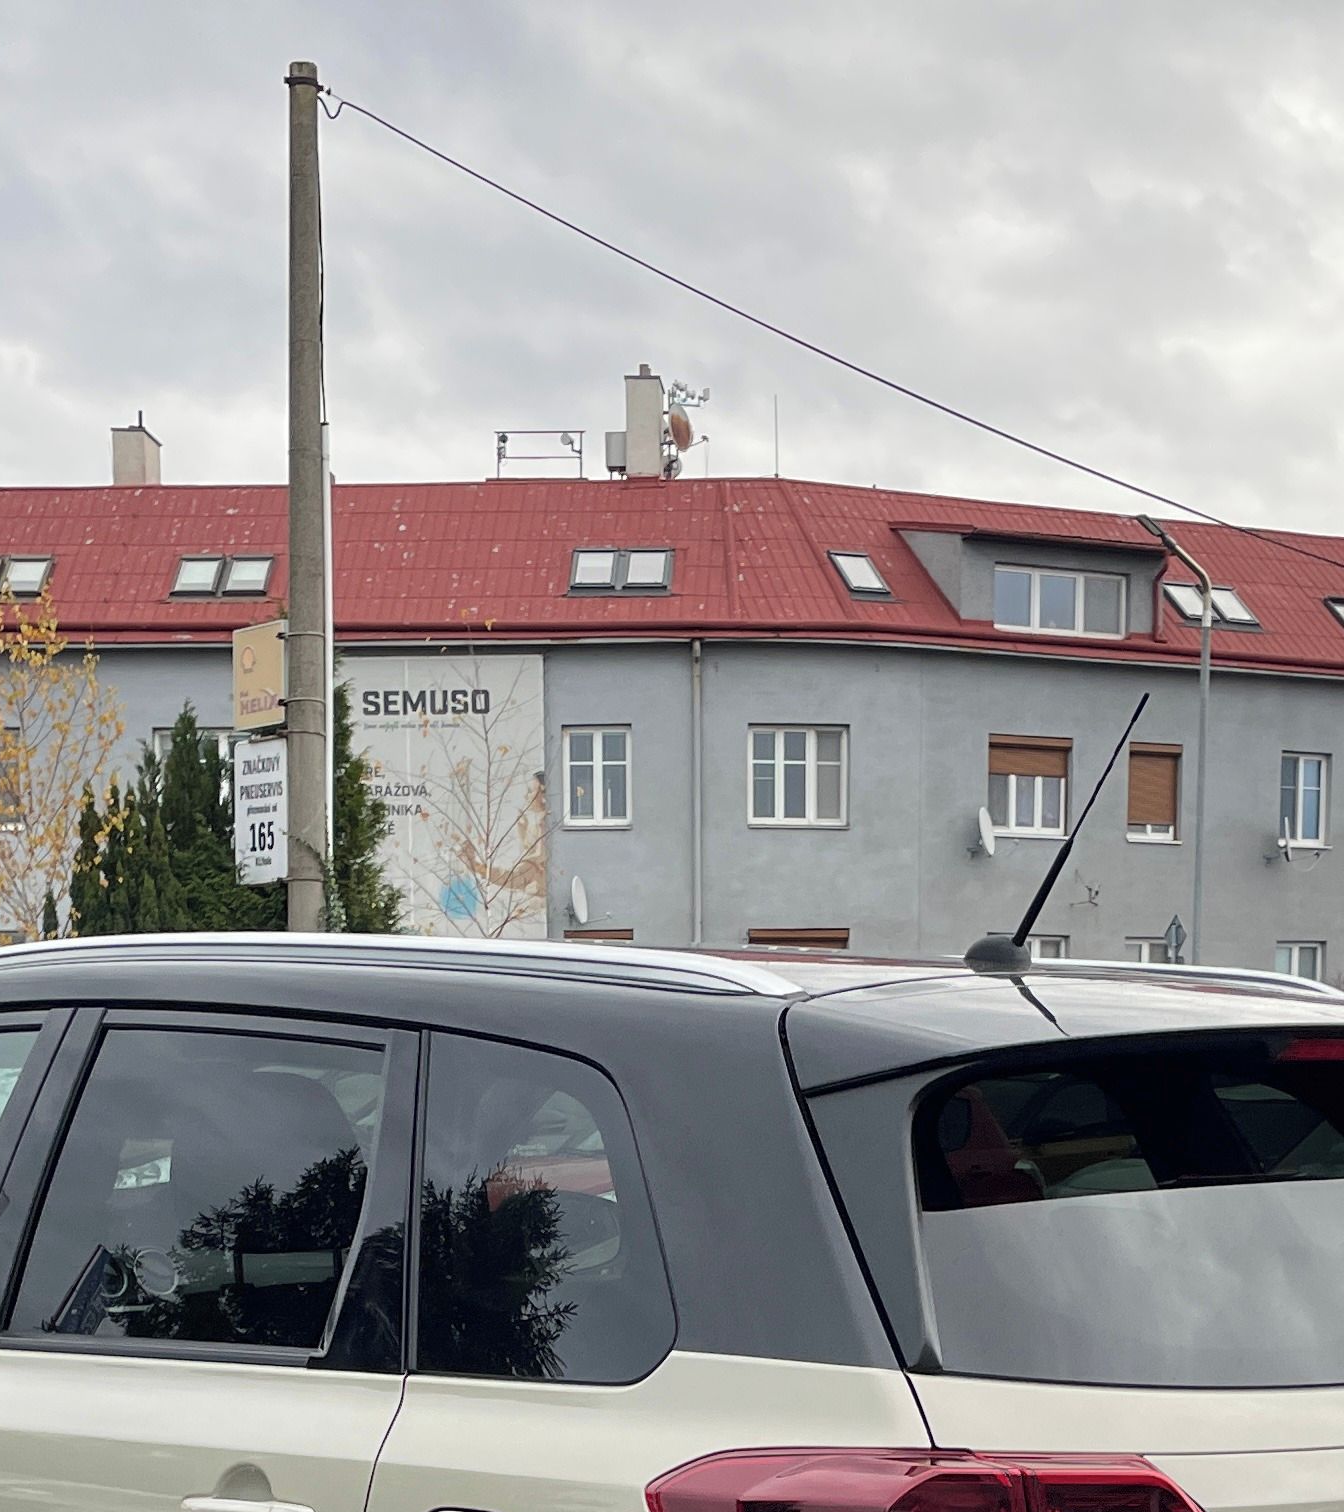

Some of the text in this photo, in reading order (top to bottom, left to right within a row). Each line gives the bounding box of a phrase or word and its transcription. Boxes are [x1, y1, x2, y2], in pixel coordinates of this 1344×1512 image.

[362, 689, 490, 716] SEMUSO
[242, 752, 281, 776] ZNAČKOVÝ
[239, 780, 284, 801] PNEUSERVIS
[367, 781, 432, 798] ARÁŽOVÁ,
[249, 821, 275, 852] 165
